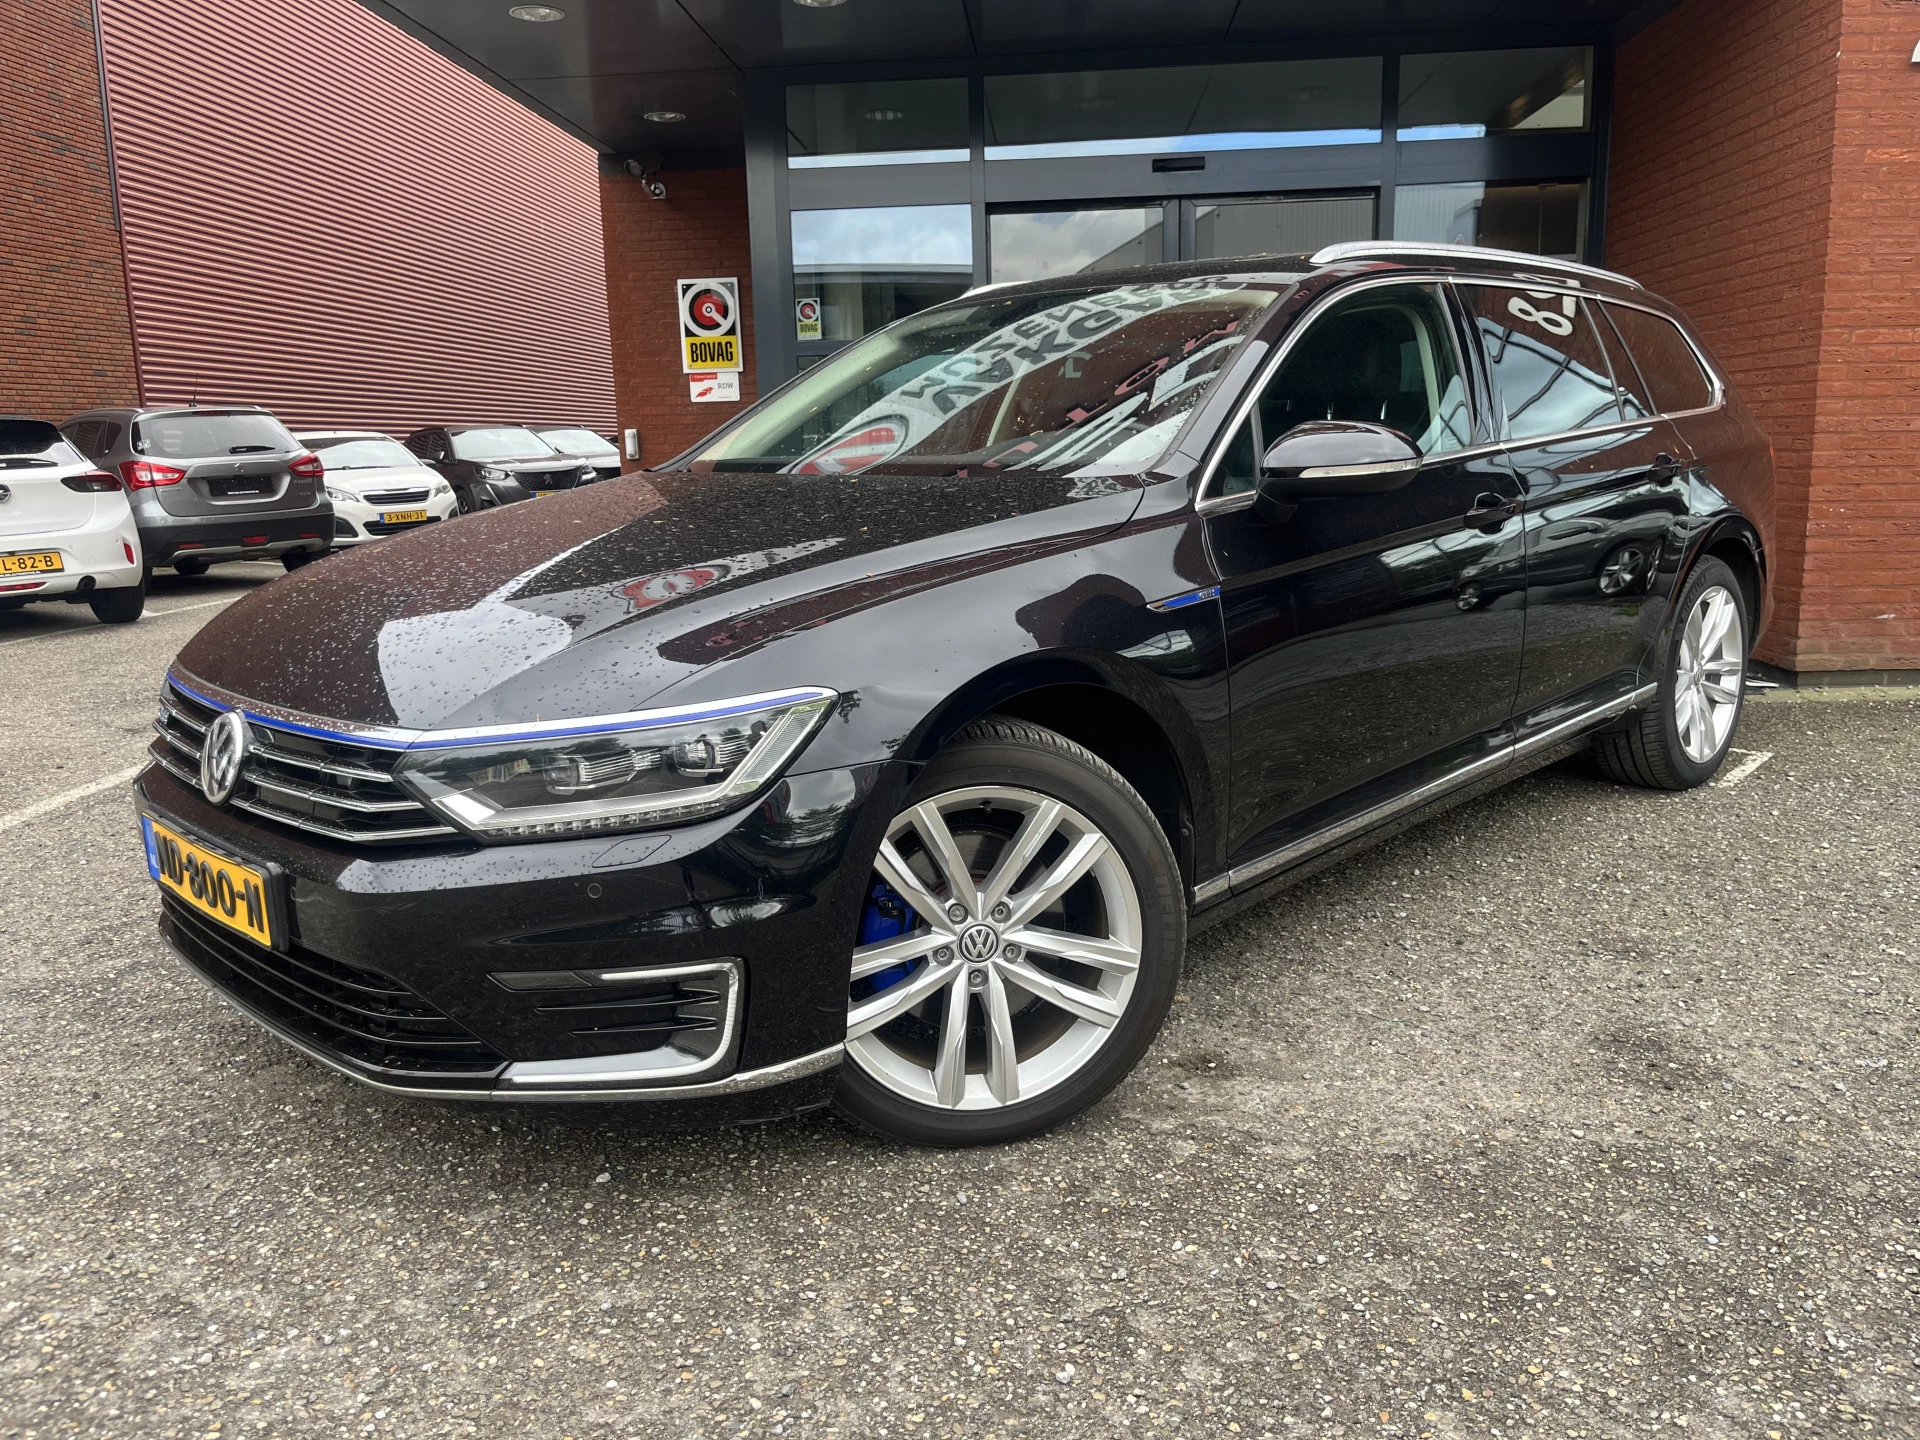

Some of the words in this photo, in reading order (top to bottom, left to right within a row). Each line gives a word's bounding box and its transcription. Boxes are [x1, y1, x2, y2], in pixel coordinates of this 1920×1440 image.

[800, 323, 818, 333] BOVAG
[690, 341, 734, 363] BOVAG
[387, 511, 423, 522] 3-XNH-31
[154, 831, 265, 934] ND-800-N
